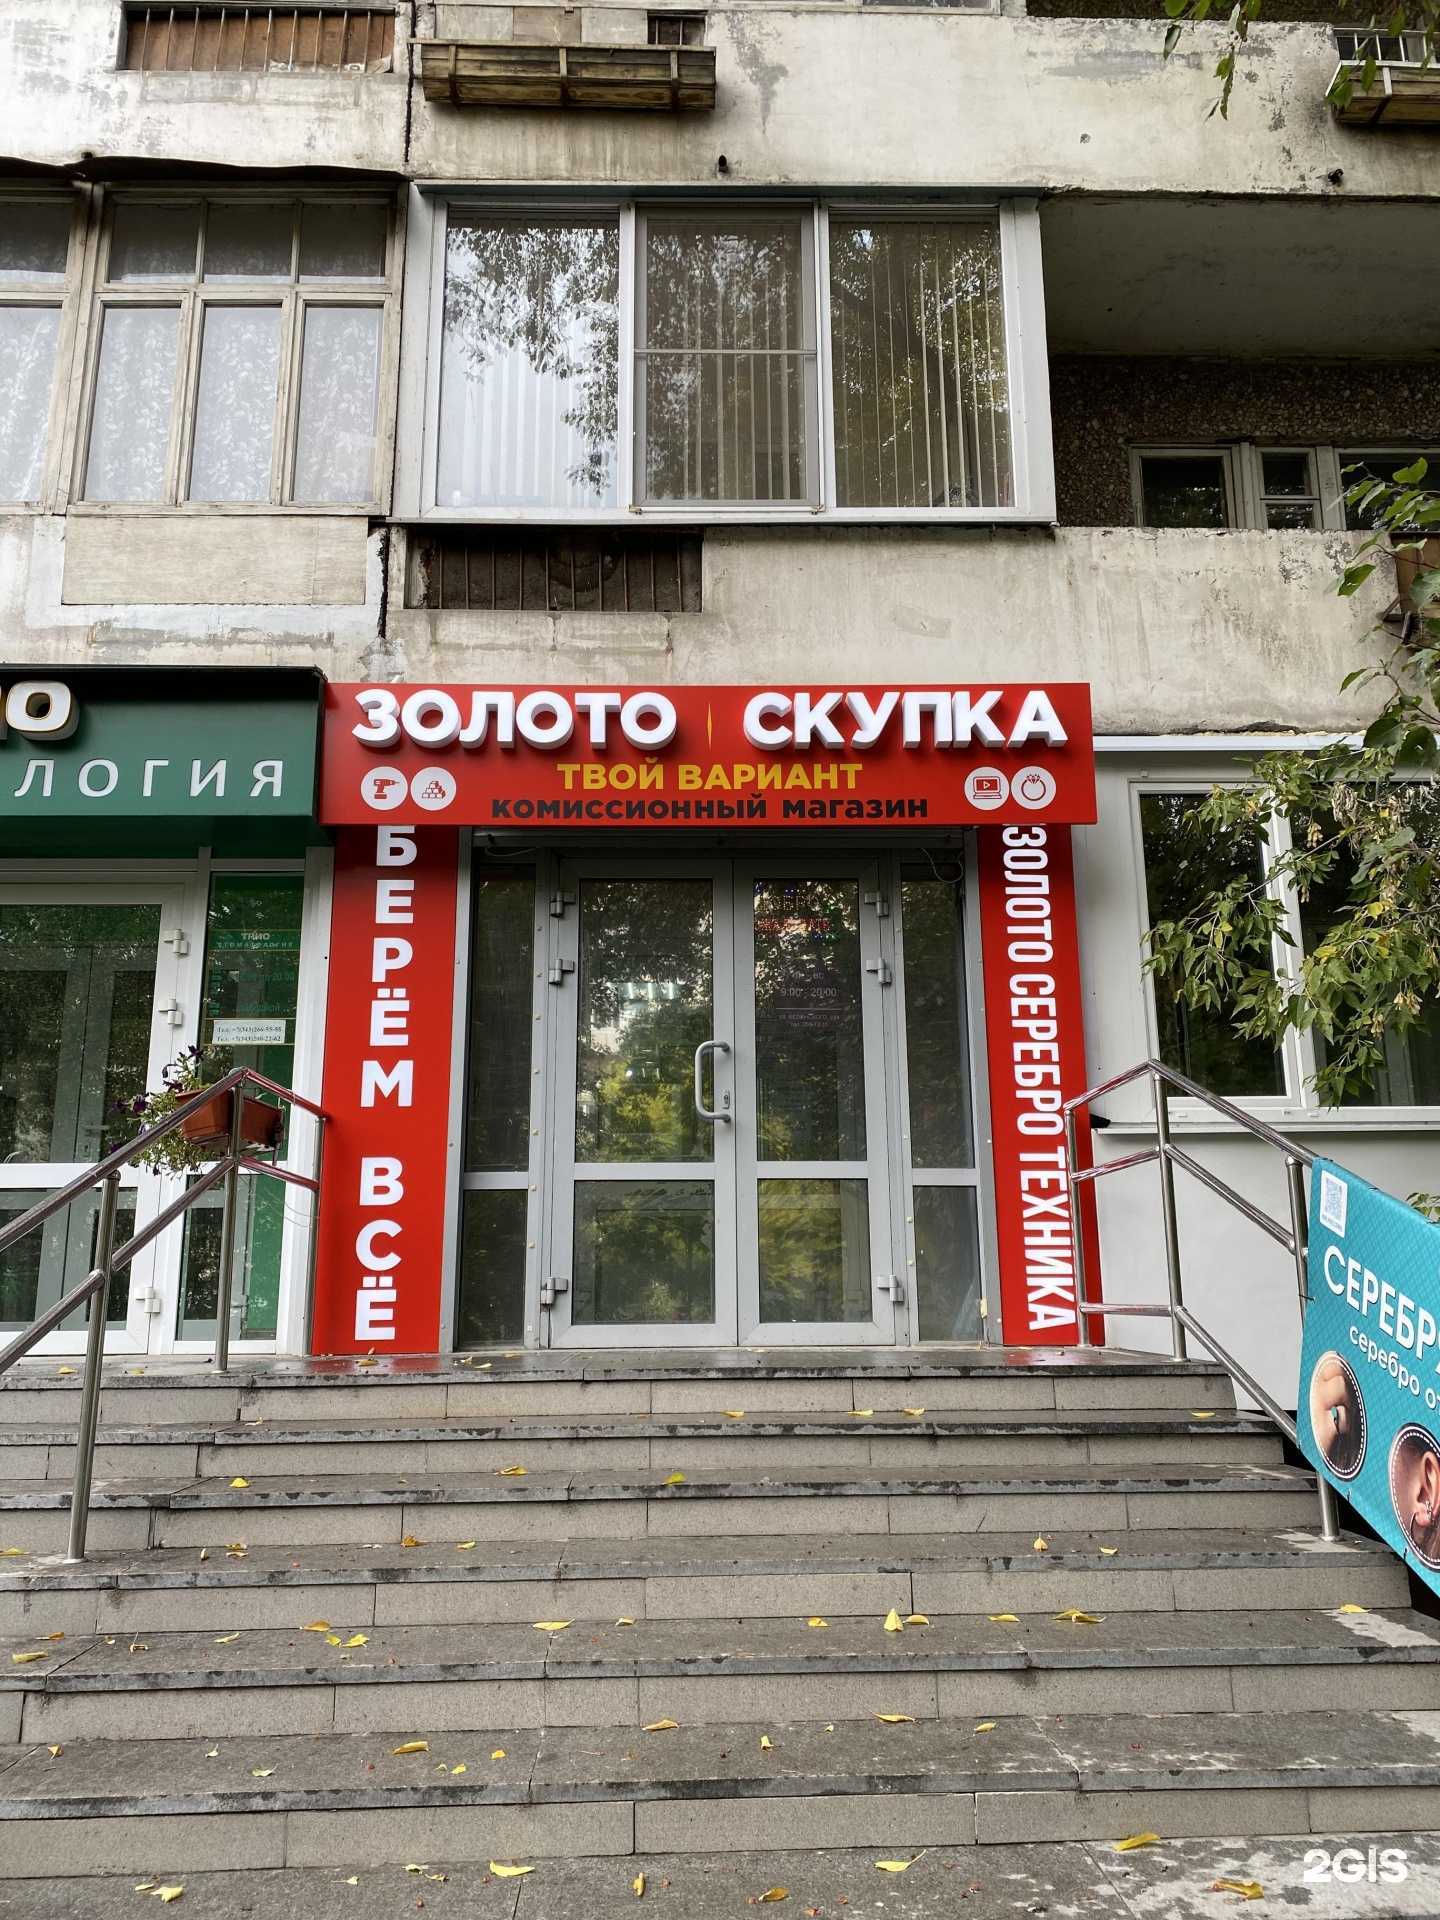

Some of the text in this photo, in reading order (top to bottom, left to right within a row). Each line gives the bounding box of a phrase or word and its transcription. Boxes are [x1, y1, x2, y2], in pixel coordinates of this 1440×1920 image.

[352, 688, 1069, 750] ЗОЛОТО СКУПКА
[491, 793, 928, 820] комиссионный магазин
[556, 757, 863, 791] ТВОЙ ВАРИАНТ
[354, 824, 418, 1341] БЕРЁМ ВСЁ
[1002, 826, 1078, 1331] ЗОЛОТО СЕРЕБРО ТЕХНИКА
[1324, 1244, 1440, 1374] СЕРЕБР
[1349, 1325, 1420, 1396] серебро
